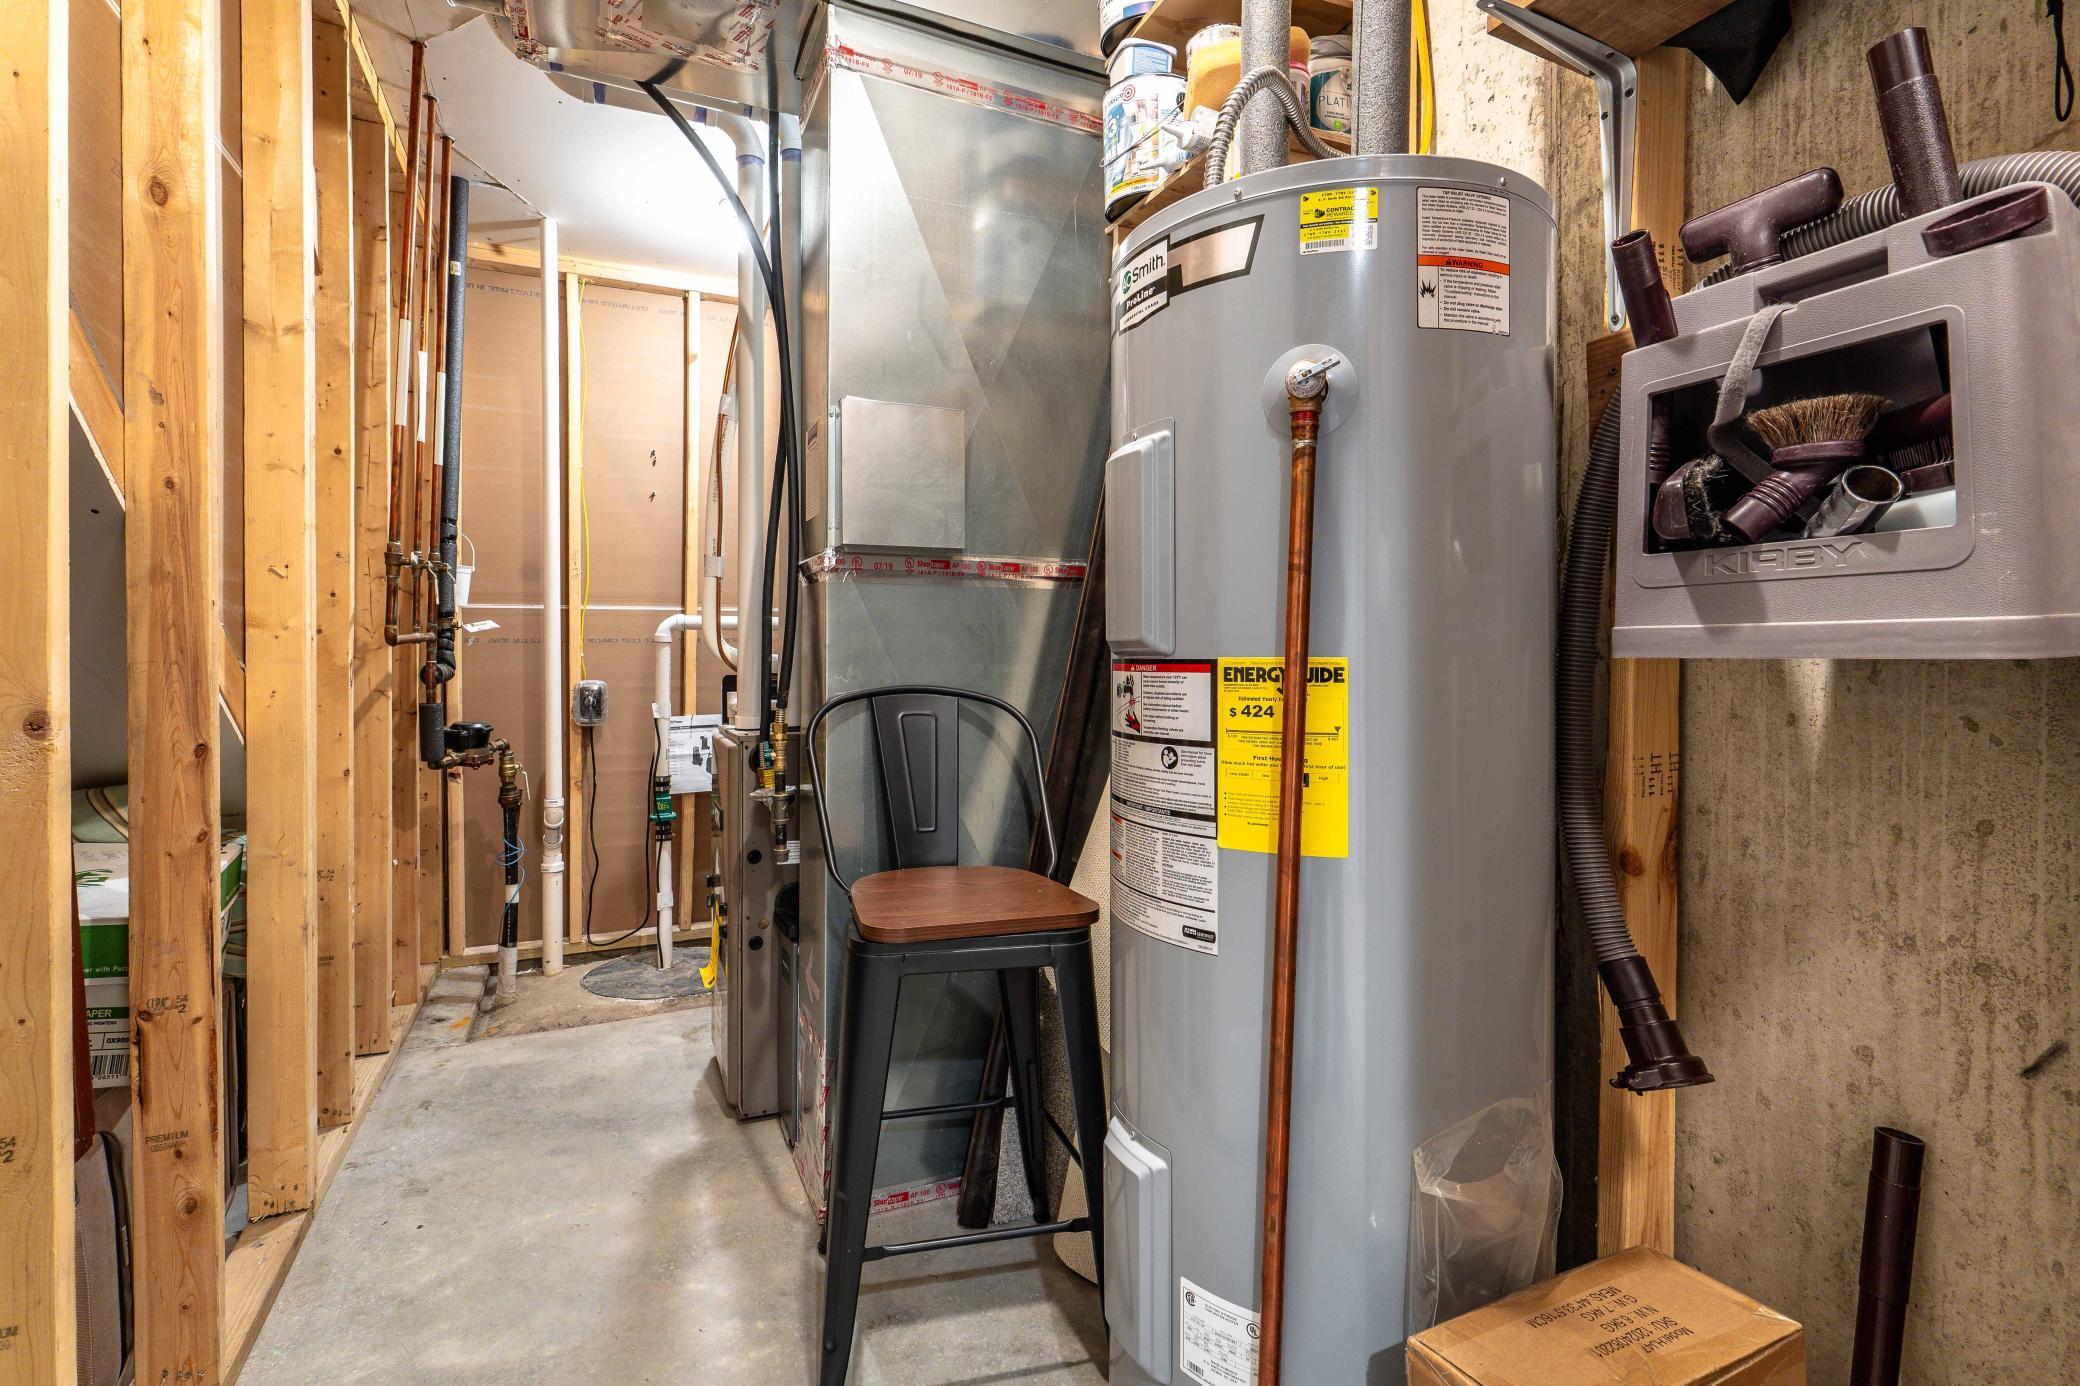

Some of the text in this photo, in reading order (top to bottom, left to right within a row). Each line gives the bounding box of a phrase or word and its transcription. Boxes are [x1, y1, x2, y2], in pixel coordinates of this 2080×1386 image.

[1319, 96, 1349, 108] PLATI
[1452, 259, 1483, 268] WARNING
[1704, 541, 1864, 576] KIRBY
[874, 562, 893, 570] 07/19
[1230, 705, 1275, 718] $ 424
[178, 1005, 186, 1013] 2
[145, 1130, 189, 1144] PREMIUM
[3, 1151, 15, 1163] 2
